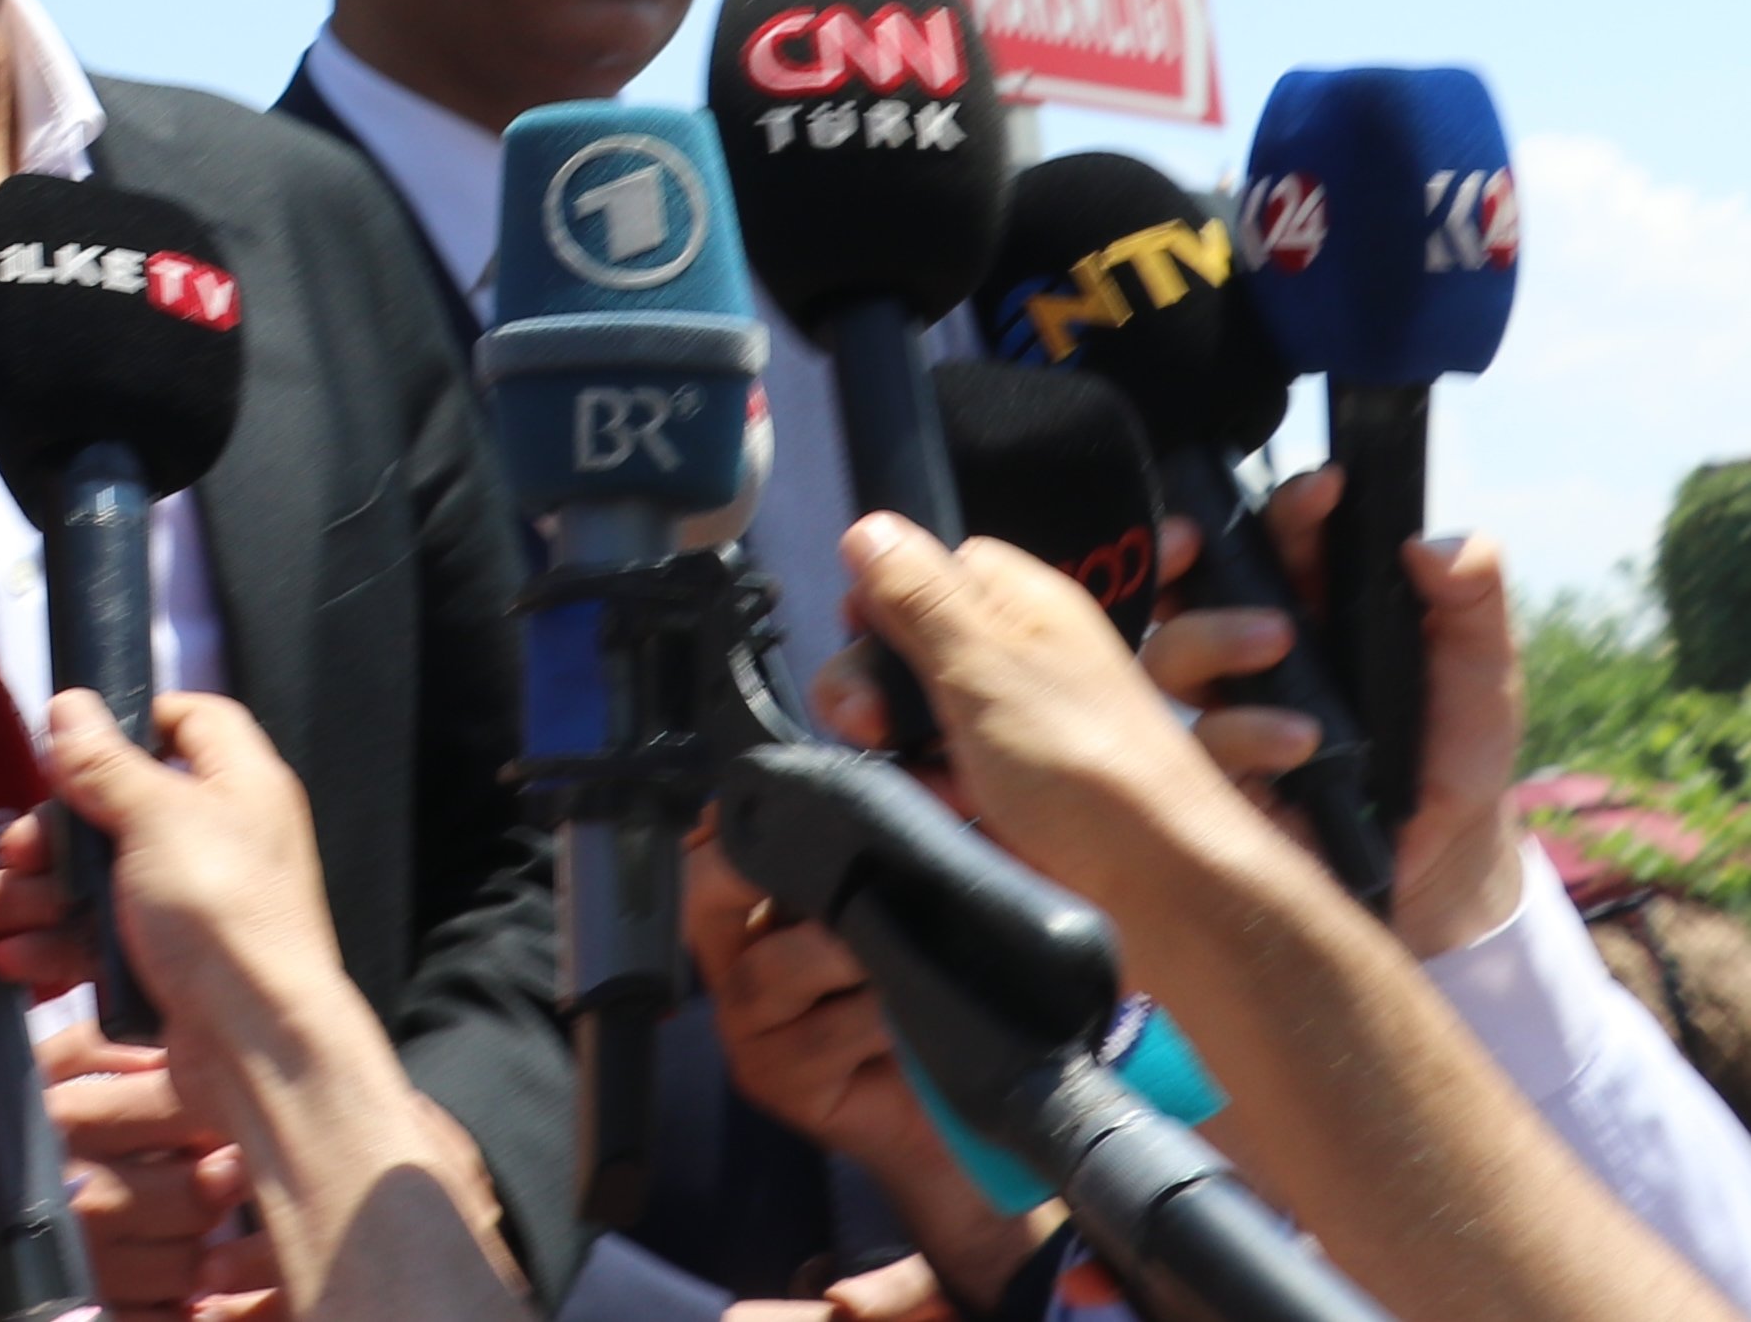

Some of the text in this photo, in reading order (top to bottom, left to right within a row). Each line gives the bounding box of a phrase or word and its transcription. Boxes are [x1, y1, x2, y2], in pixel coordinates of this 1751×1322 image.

[744, 2, 968, 98] CNN
[755, 98, 968, 155] TÜRK
[1025, 217, 1233, 364] NTV
